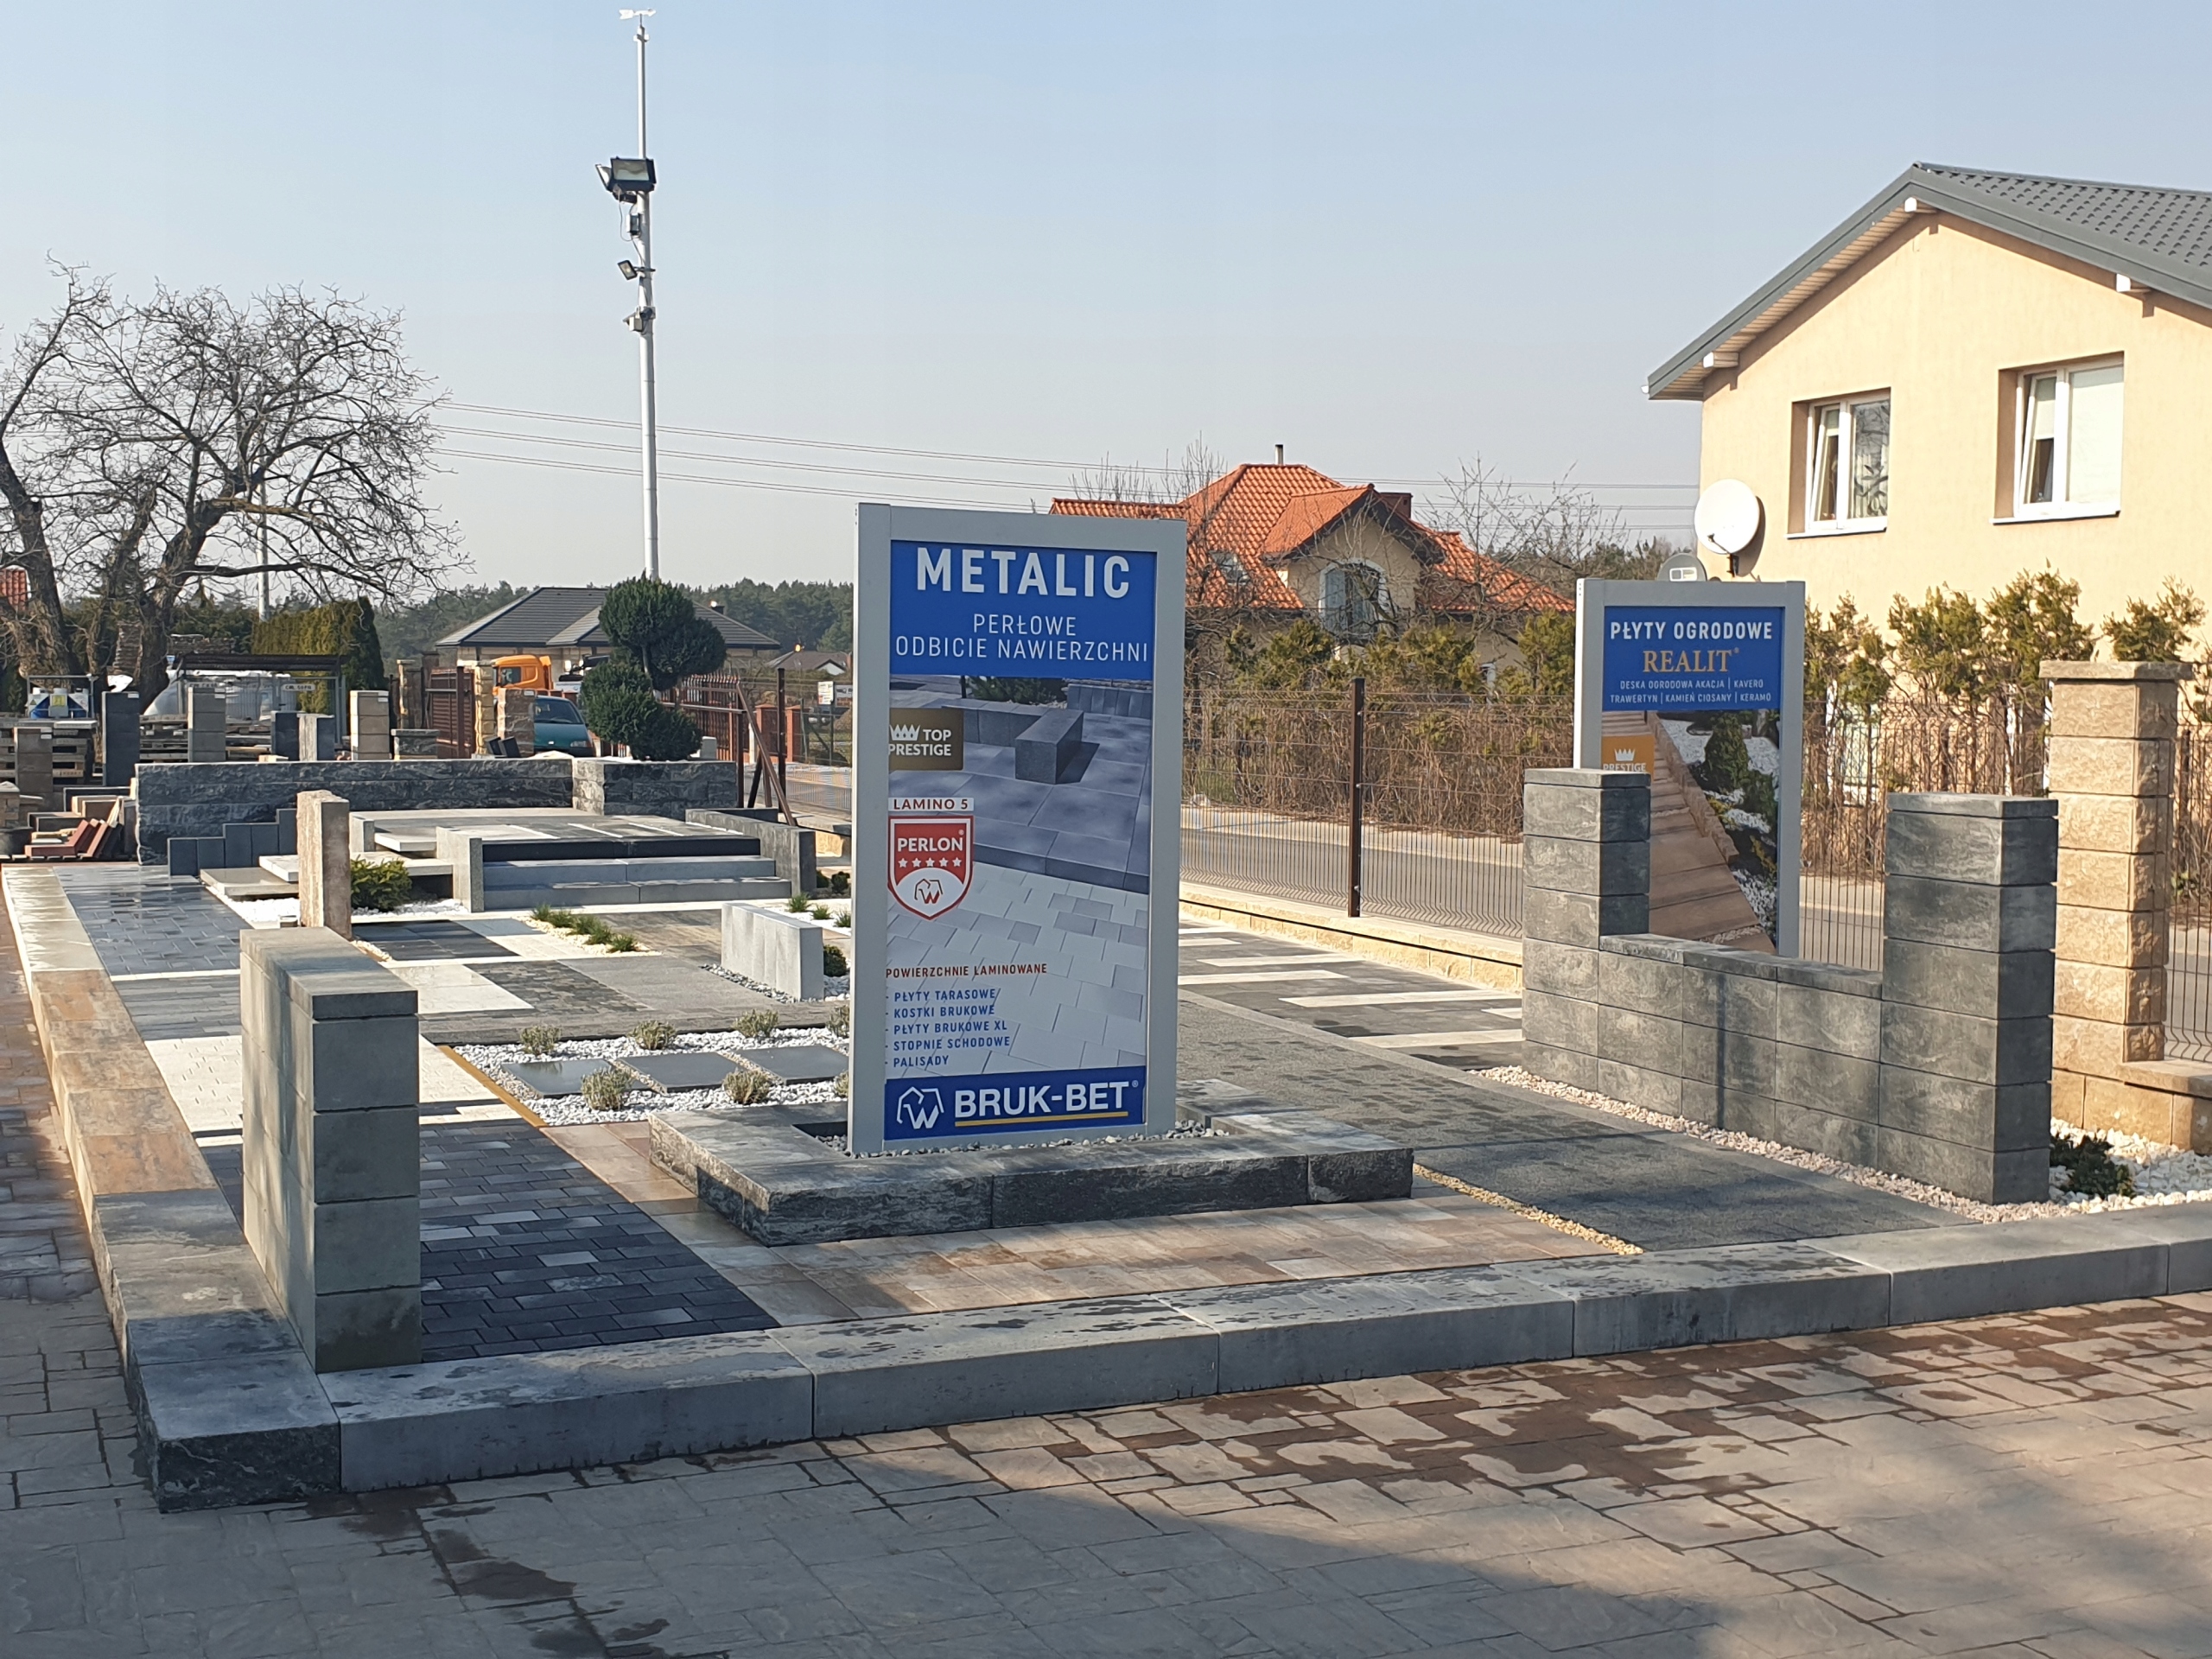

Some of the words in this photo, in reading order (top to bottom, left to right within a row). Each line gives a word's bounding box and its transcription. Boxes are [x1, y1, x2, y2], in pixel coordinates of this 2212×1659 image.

[916, 546, 1130, 599] METALIC
[973, 613, 1077, 636] PERŁOWE
[1610, 621, 1667, 640] PŁYTY
[1673, 621, 1772, 639] OGRODOWE
[895, 635, 988, 658] ODBICIE
[997, 639, 1148, 663] NAWIERZCHNI
[1643, 649, 1732, 672] REALIT
[1619, 680, 1646, 690] DESKA
[1648, 679, 1694, 690] OGRODOWA
[1695, 679, 1725, 690] AKACJA
[1733, 678, 1764, 689] KAVERO
[1610, 694, 1658, 703] TRAWERTYN
[1665, 691, 1695, 703] KAMIEŃ
[1697, 693, 1732, 702] CIOSANY
[1739, 692, 1771, 702] KERAMO
[923, 728, 952, 741] TOP
[888, 743, 952, 756] PRESTIGE
[893, 798, 955, 810] LAMINO
[960, 798, 969, 810] 5
[897, 836, 963, 852] PERLON
[886, 966, 969, 979] POWIERZCHNIE
[974, 963, 1047, 976] LAMINOWANE
[894, 991, 930, 1002] PŁYTY
[935, 988, 995, 1001] TARASOWE
[893, 1007, 935, 1019] KOSTKI
[940, 1004, 995, 1017] BRUKOWE
[893, 1023, 929, 1035] PŁYTY
[934, 1020, 990, 1033] BRUKOWE
[994, 1020, 1007, 1031] XL
[893, 1039, 943, 1052] STOPNIE
[947, 1036, 1010, 1049] SCHODOWE
[893, 1055, 950, 1068] PALISADY
[954, 1081, 1130, 1119] BRUK-BET
